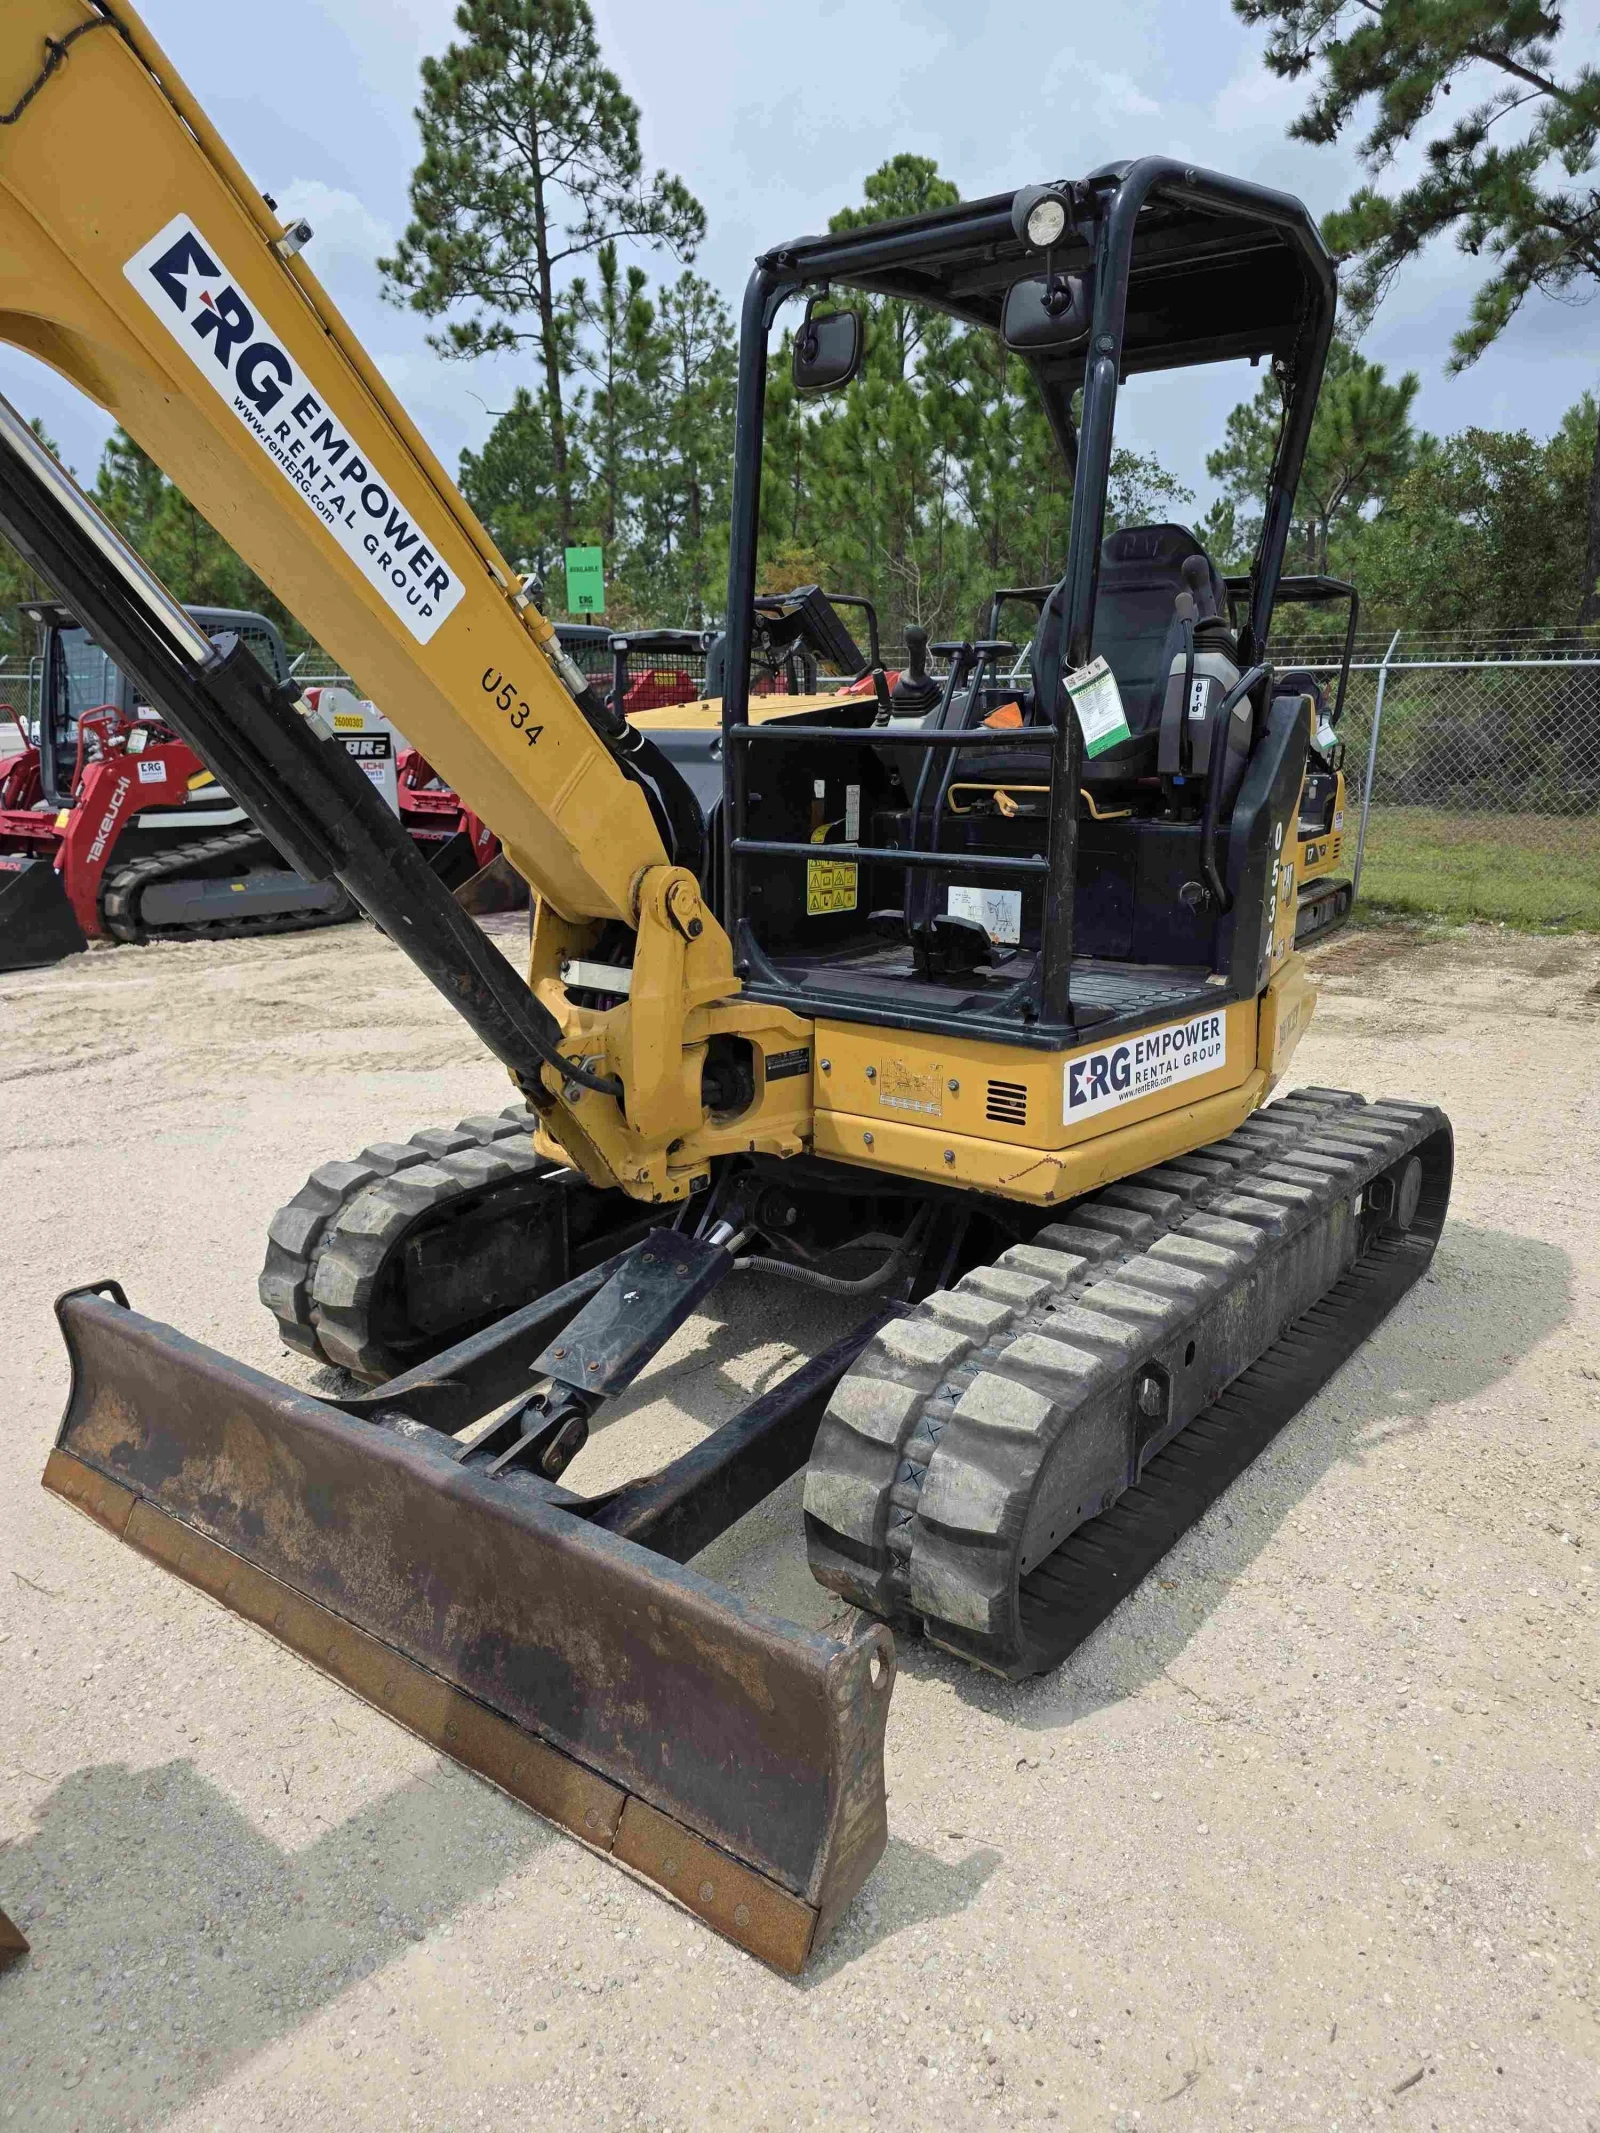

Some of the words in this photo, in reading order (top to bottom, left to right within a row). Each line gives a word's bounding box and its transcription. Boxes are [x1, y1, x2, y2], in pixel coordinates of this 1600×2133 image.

[233, 396, 335, 523] www.rentERG.com
[274, 420, 357, 529] RENTAL
[363, 534, 433, 617] GROUP
[290, 393, 450, 602] EMPOWER
[141, 762, 161, 772] ERG
[1135, 1016, 1220, 1065] EMPOWER
[1135, 1058, 1179, 1085] RENTAL
[1184, 1042, 1221, 1066] GROUP
[1069, 1046, 1131, 1108] ERG
[1118, 1075, 1172, 1101] www.rentERG.com
